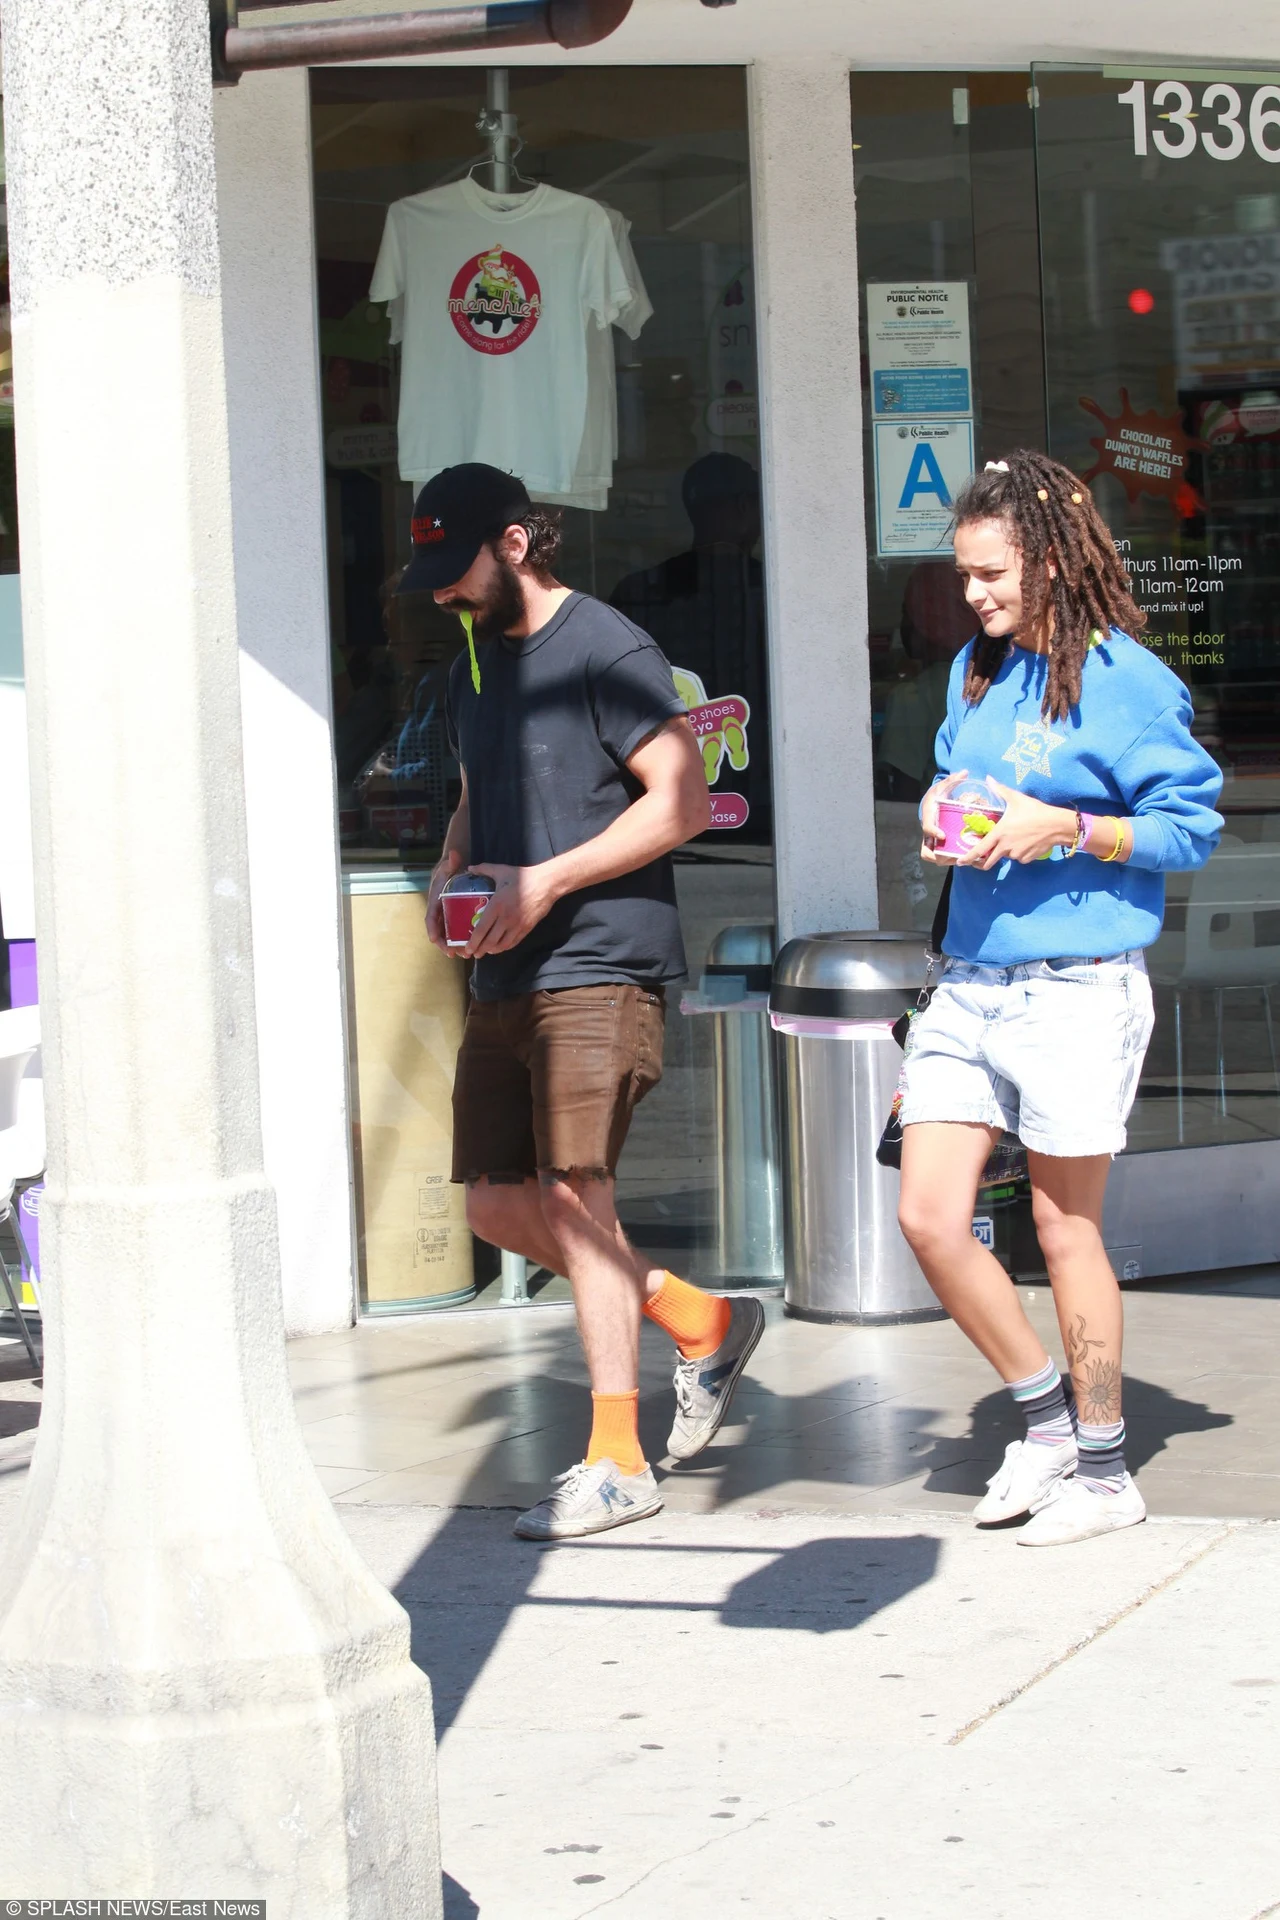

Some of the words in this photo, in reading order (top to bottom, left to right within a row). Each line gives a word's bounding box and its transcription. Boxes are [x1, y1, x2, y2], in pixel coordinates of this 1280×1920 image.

[1118, 80, 1280, 163] 1336
[447, 289, 542, 318] menchie's
[886, 294, 916, 303] PUBLIC
[918, 294, 949, 302] NOTICE
[1120, 428, 1172, 450] CHOCOLATE
[1105, 438, 1141, 456] DUNK'D
[1142, 447, 1184, 467] WAFFLES
[898, 443, 954, 508] A
[1113, 455, 1137, 471] ARE
[1138, 460, 1172, 479] HERE!
[1122, 557, 1157, 573] thurs
[1140, 602, 1159, 613] and
[1161, 601, 1178, 612] mix
[1180, 601, 1186, 611] it
[1188, 600, 1204, 614] up!
[1167, 632, 1189, 646] the
[1193, 631, 1226, 645] door
[1181, 650, 1225, 666] thanks
[699, 704, 736, 721] shoes
